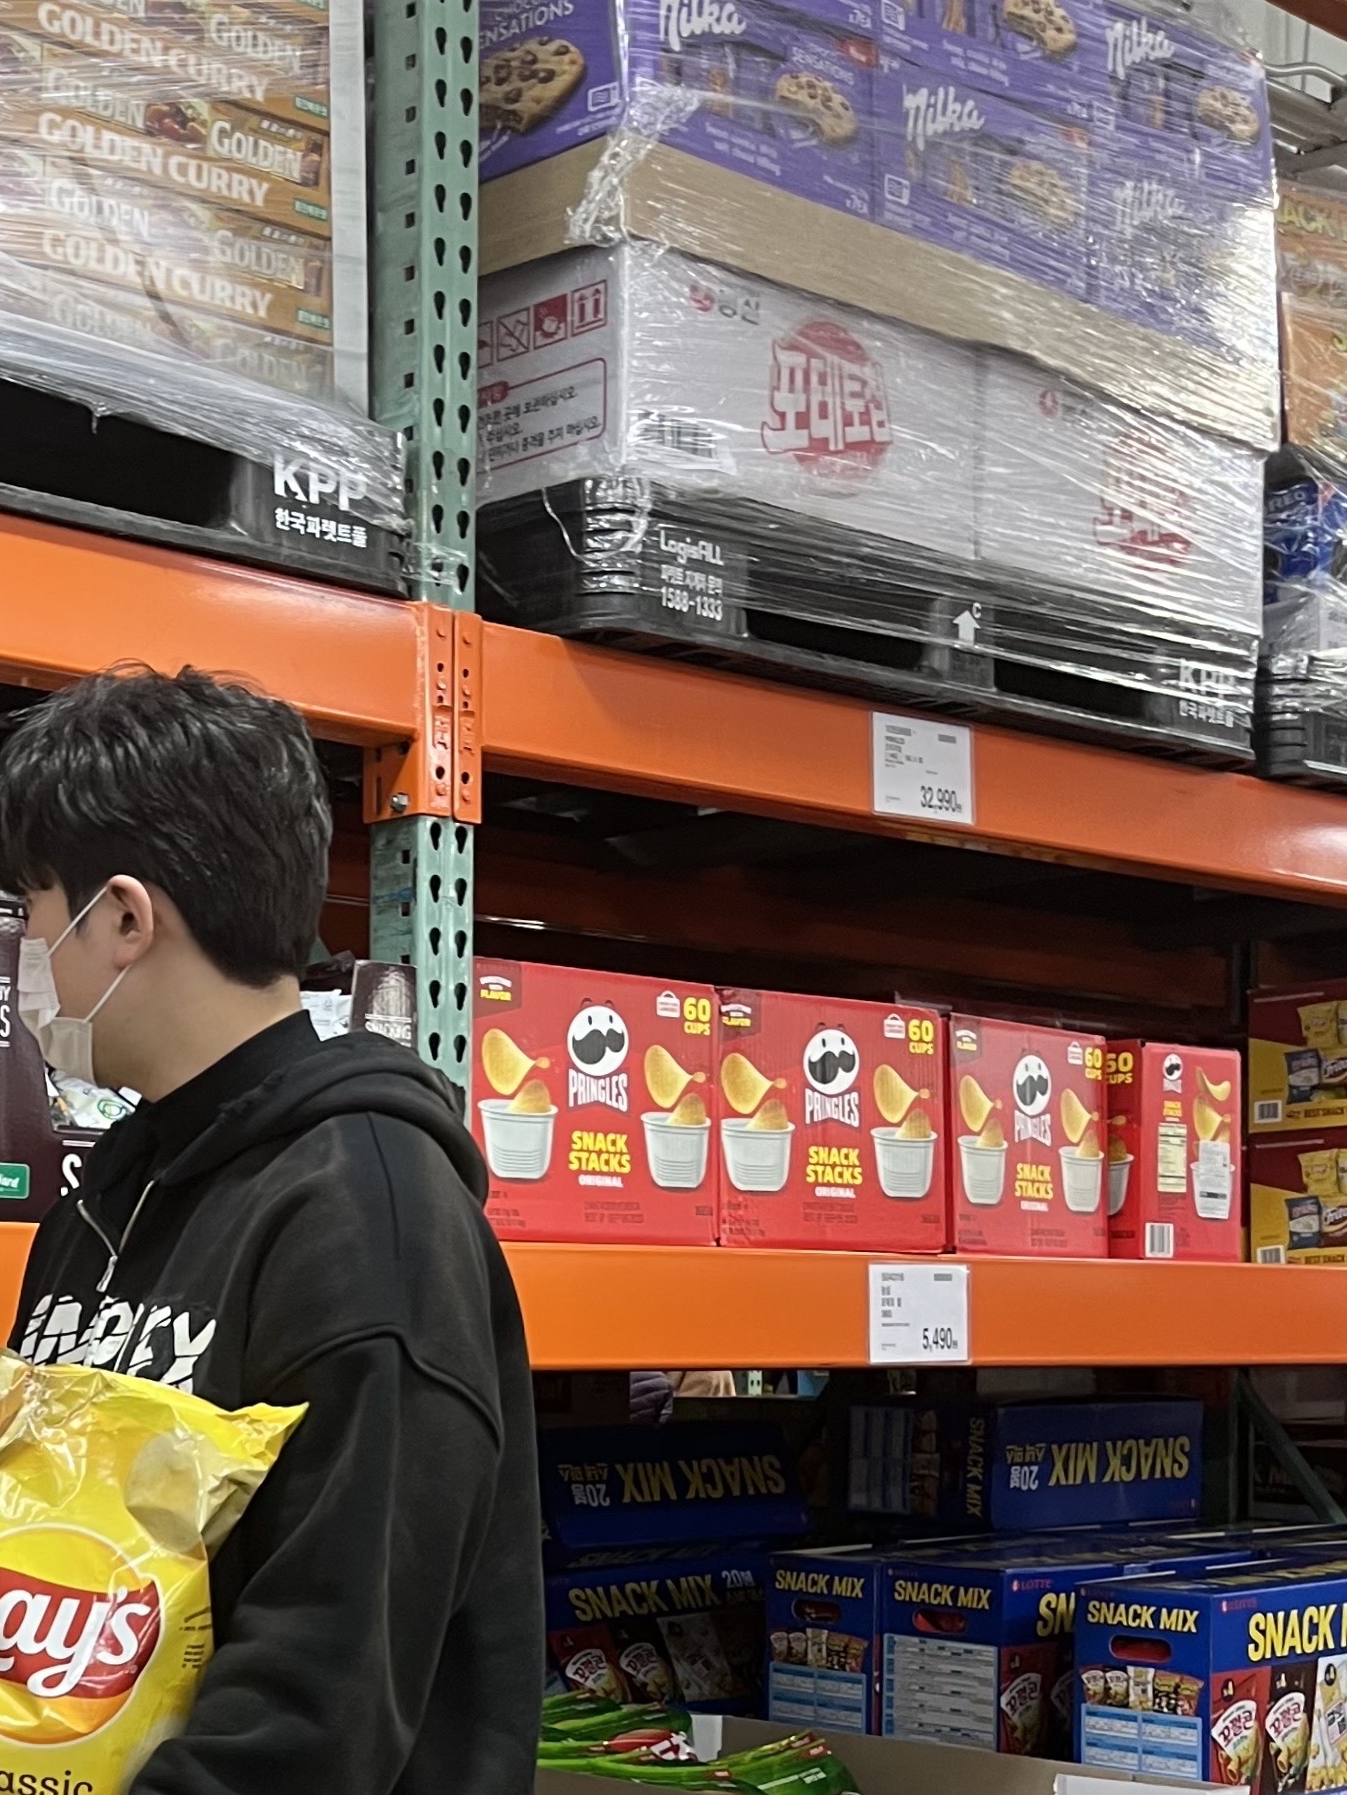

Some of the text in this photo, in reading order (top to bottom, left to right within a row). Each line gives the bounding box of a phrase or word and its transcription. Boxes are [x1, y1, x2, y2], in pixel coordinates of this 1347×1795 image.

[659, 0, 747, 52] Milka
[39, 1, 269, 102] GOLDEN CURRY
[1106, 17, 1175, 80] Milka
[903, 84, 985, 151] Milka
[39, 111, 270, 207] GOLDEN CURRY
[211, 120, 303, 184] GOLDEN
[43, 230, 168, 292] GOLDEN
[174, 267, 273, 320] CURRY
[274, 451, 367, 511] KPP
[274, 507, 368, 548] 한국파렛트풀
[683, 997, 711, 1022] 60
[683, 1021, 711, 1036] CUPS
[908, 1019, 934, 1043] 60
[909, 1041, 934, 1056] CUPS
[569, 1067, 628, 1112] PRINGLES
[804, 1087, 860, 1128] PRINGLES
[571, 1130, 628, 1154] SNACK
[807, 1145, 860, 1167] SNACK
[568, 1150, 631, 1174] STACKS
[805, 1164, 863, 1186] STACKS
[578, 1174, 624, 1189] ORIGINAL
[923, 1327, 953, 1352] 5,490
[1048, 1435, 1190, 1487] SNACK MIX
[568, 1575, 720, 1622] SNACK MIX
[774, 1569, 866, 1598] SNACK MIX
[893, 1580, 993, 1610] SNACK MIX
[1020, 1579, 1052, 1591] LOTTE
[1087, 1600, 1155, 1629] SNACK
[1160, 1608, 1200, 1633] MIX
[1248, 1603, 1335, 1662] SNACK
